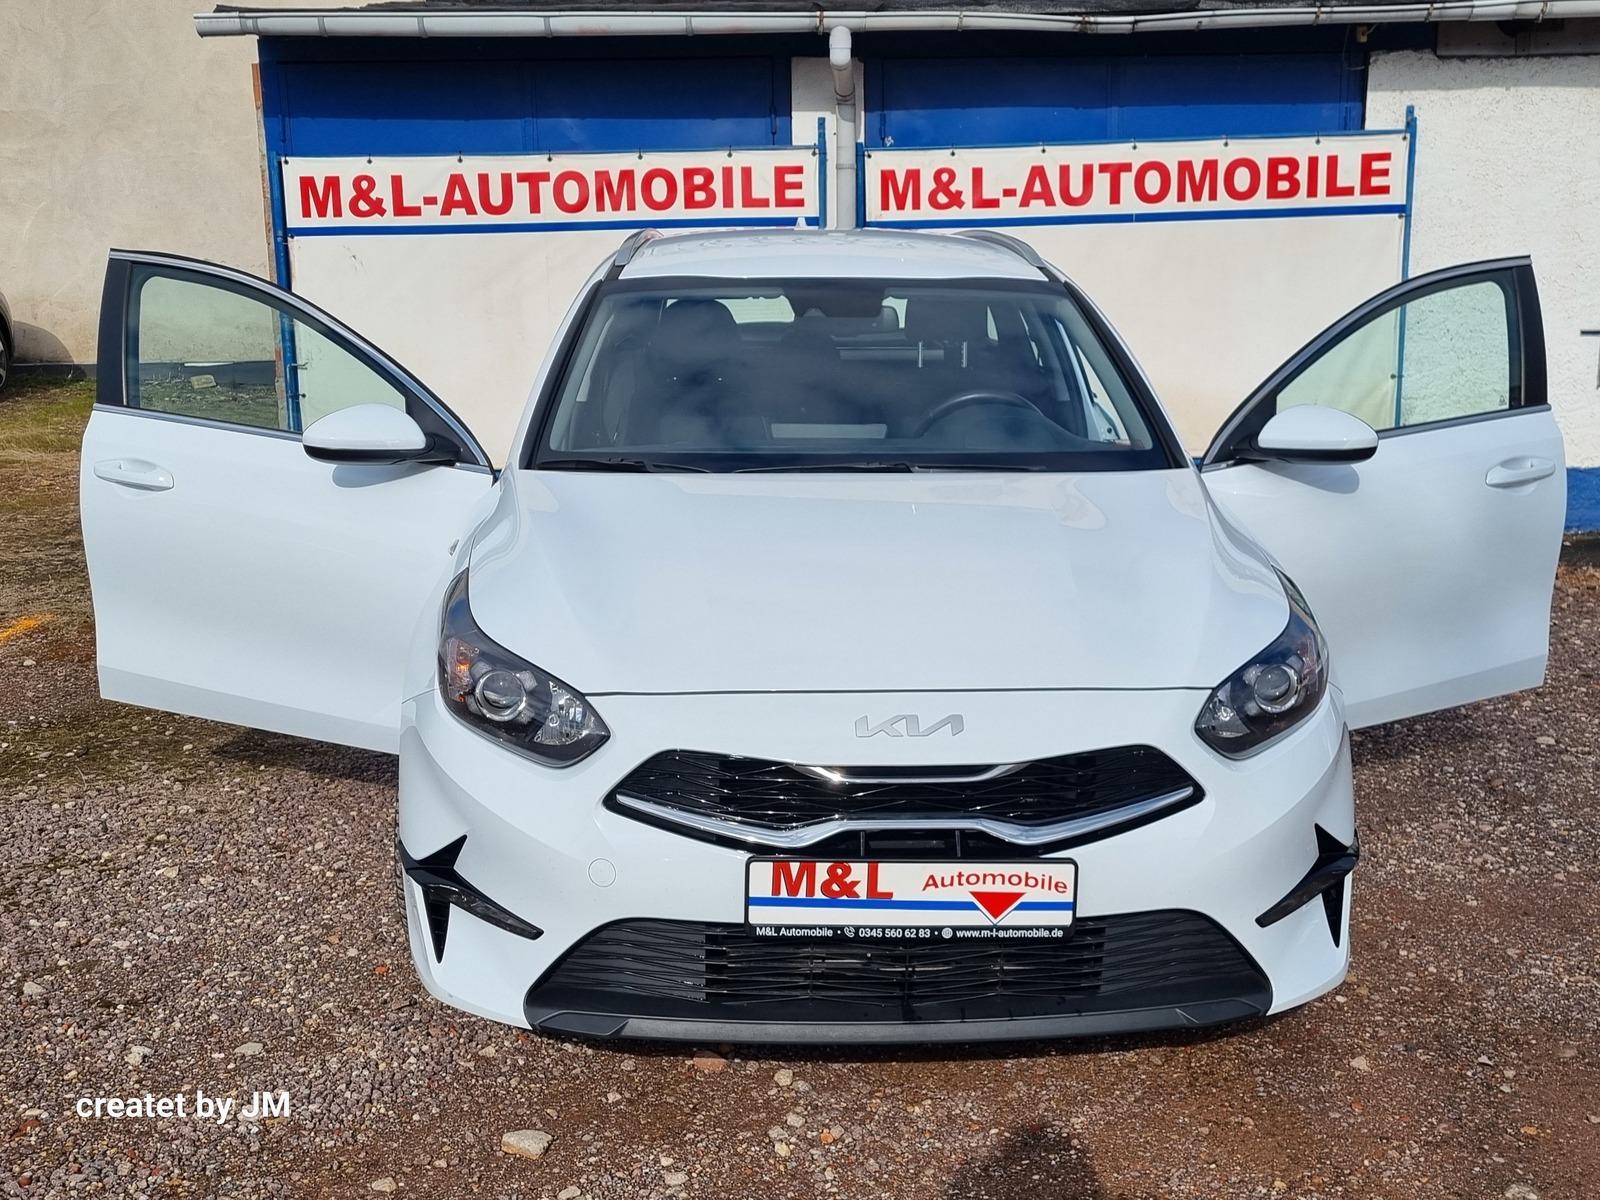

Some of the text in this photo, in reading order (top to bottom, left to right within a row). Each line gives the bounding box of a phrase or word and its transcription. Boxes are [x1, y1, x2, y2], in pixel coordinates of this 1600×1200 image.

[299, 165, 806, 218] M&L-AUTOMOBILE
[880, 151, 1392, 211] M&L-AUTOMOBILE
[854, 714, 965, 738] KIA
[771, 861, 1069, 900] M&L Automobile
[756, 926, 1064, 938] M&L Automobile 0345 560 62 83 www.m-l-automobile.de
